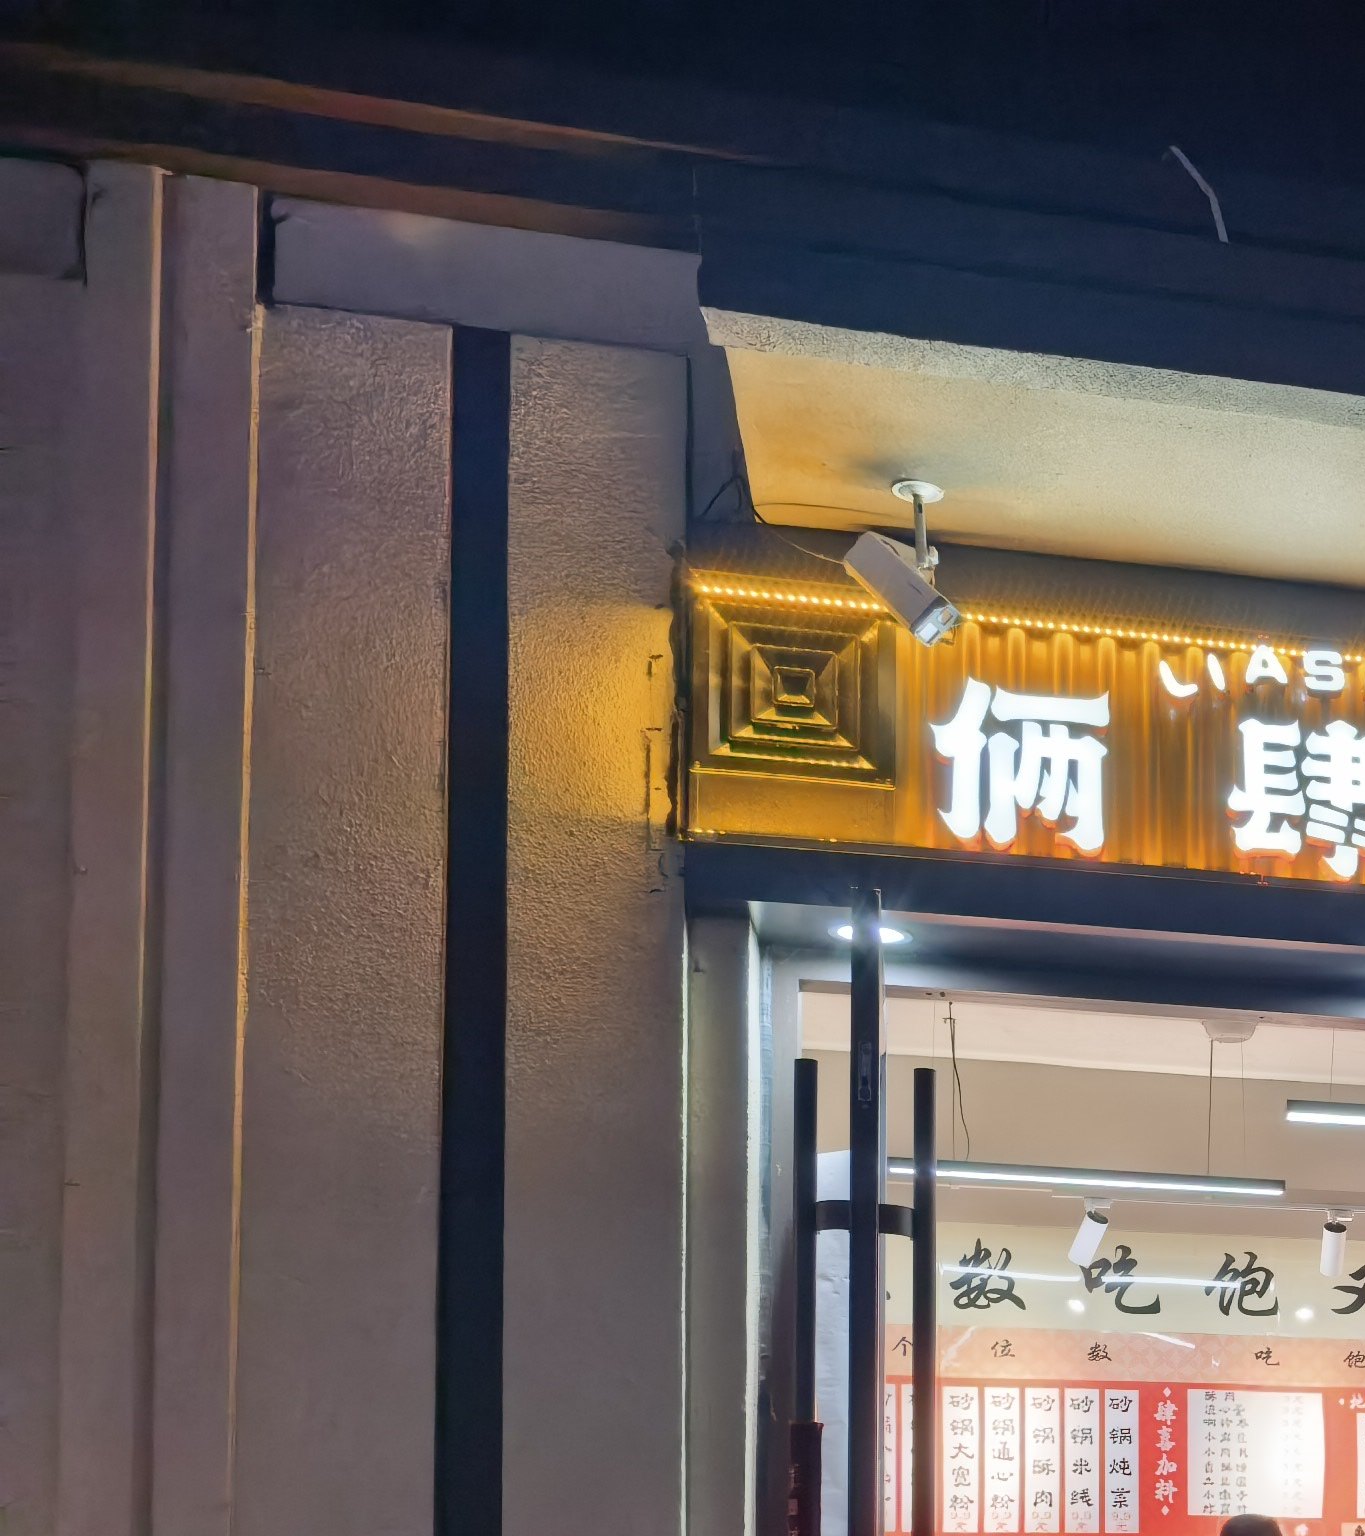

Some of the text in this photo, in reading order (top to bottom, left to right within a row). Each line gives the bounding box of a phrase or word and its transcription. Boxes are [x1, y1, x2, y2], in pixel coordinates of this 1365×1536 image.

[949, 1394, 975, 1511] 砂锅大宽粉
[1069, 1395, 1095, 1508] 砂锅米线
[1108, 1395, 1133, 1509] 砂锅炖菜
